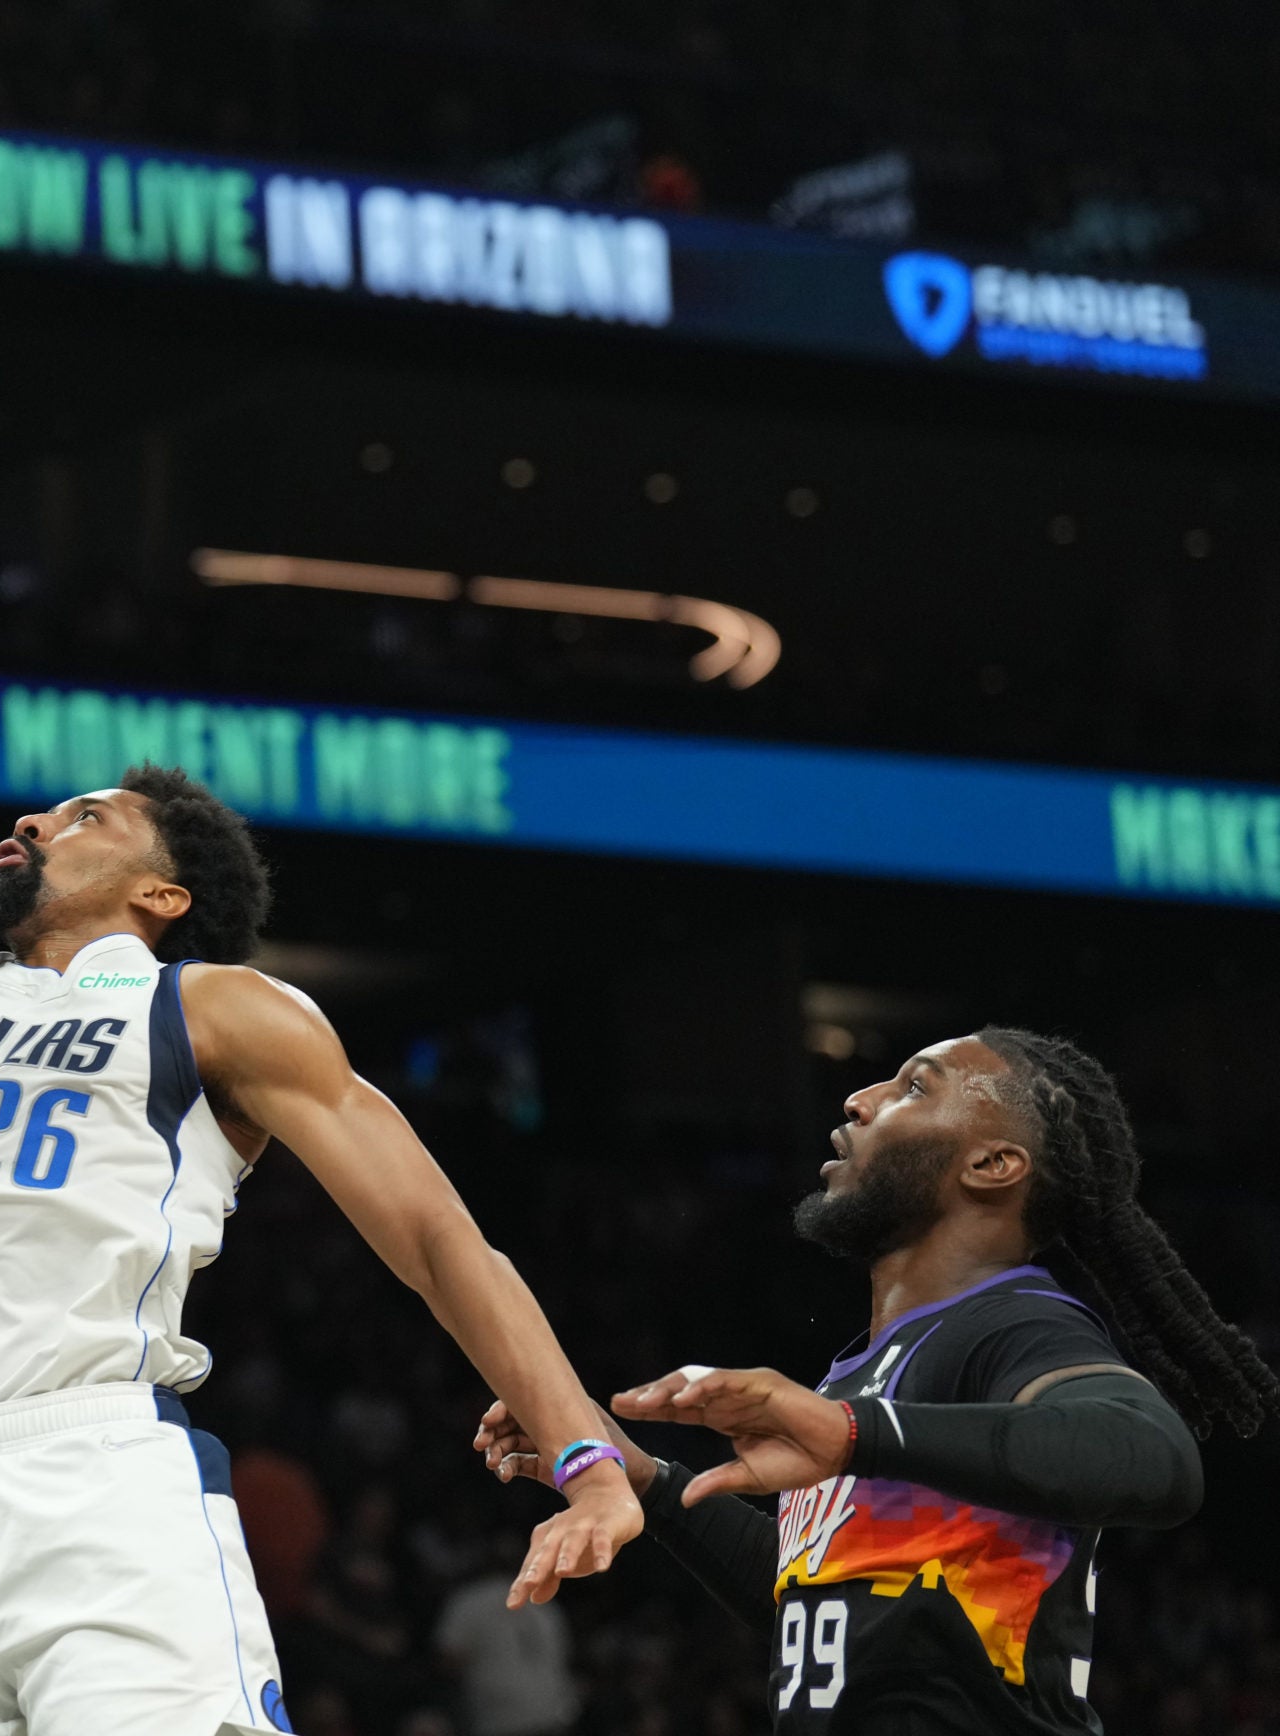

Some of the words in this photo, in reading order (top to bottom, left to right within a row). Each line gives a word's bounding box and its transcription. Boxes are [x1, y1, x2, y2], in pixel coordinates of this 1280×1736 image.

[101, 155, 257, 277] LIVE
[266, 175, 351, 288] IN
[2, 683, 302, 818] MOMENT
[312, 712, 511, 835] MORE
[78, 972, 151, 990] chime
[778, 1599, 849, 1712] 99
